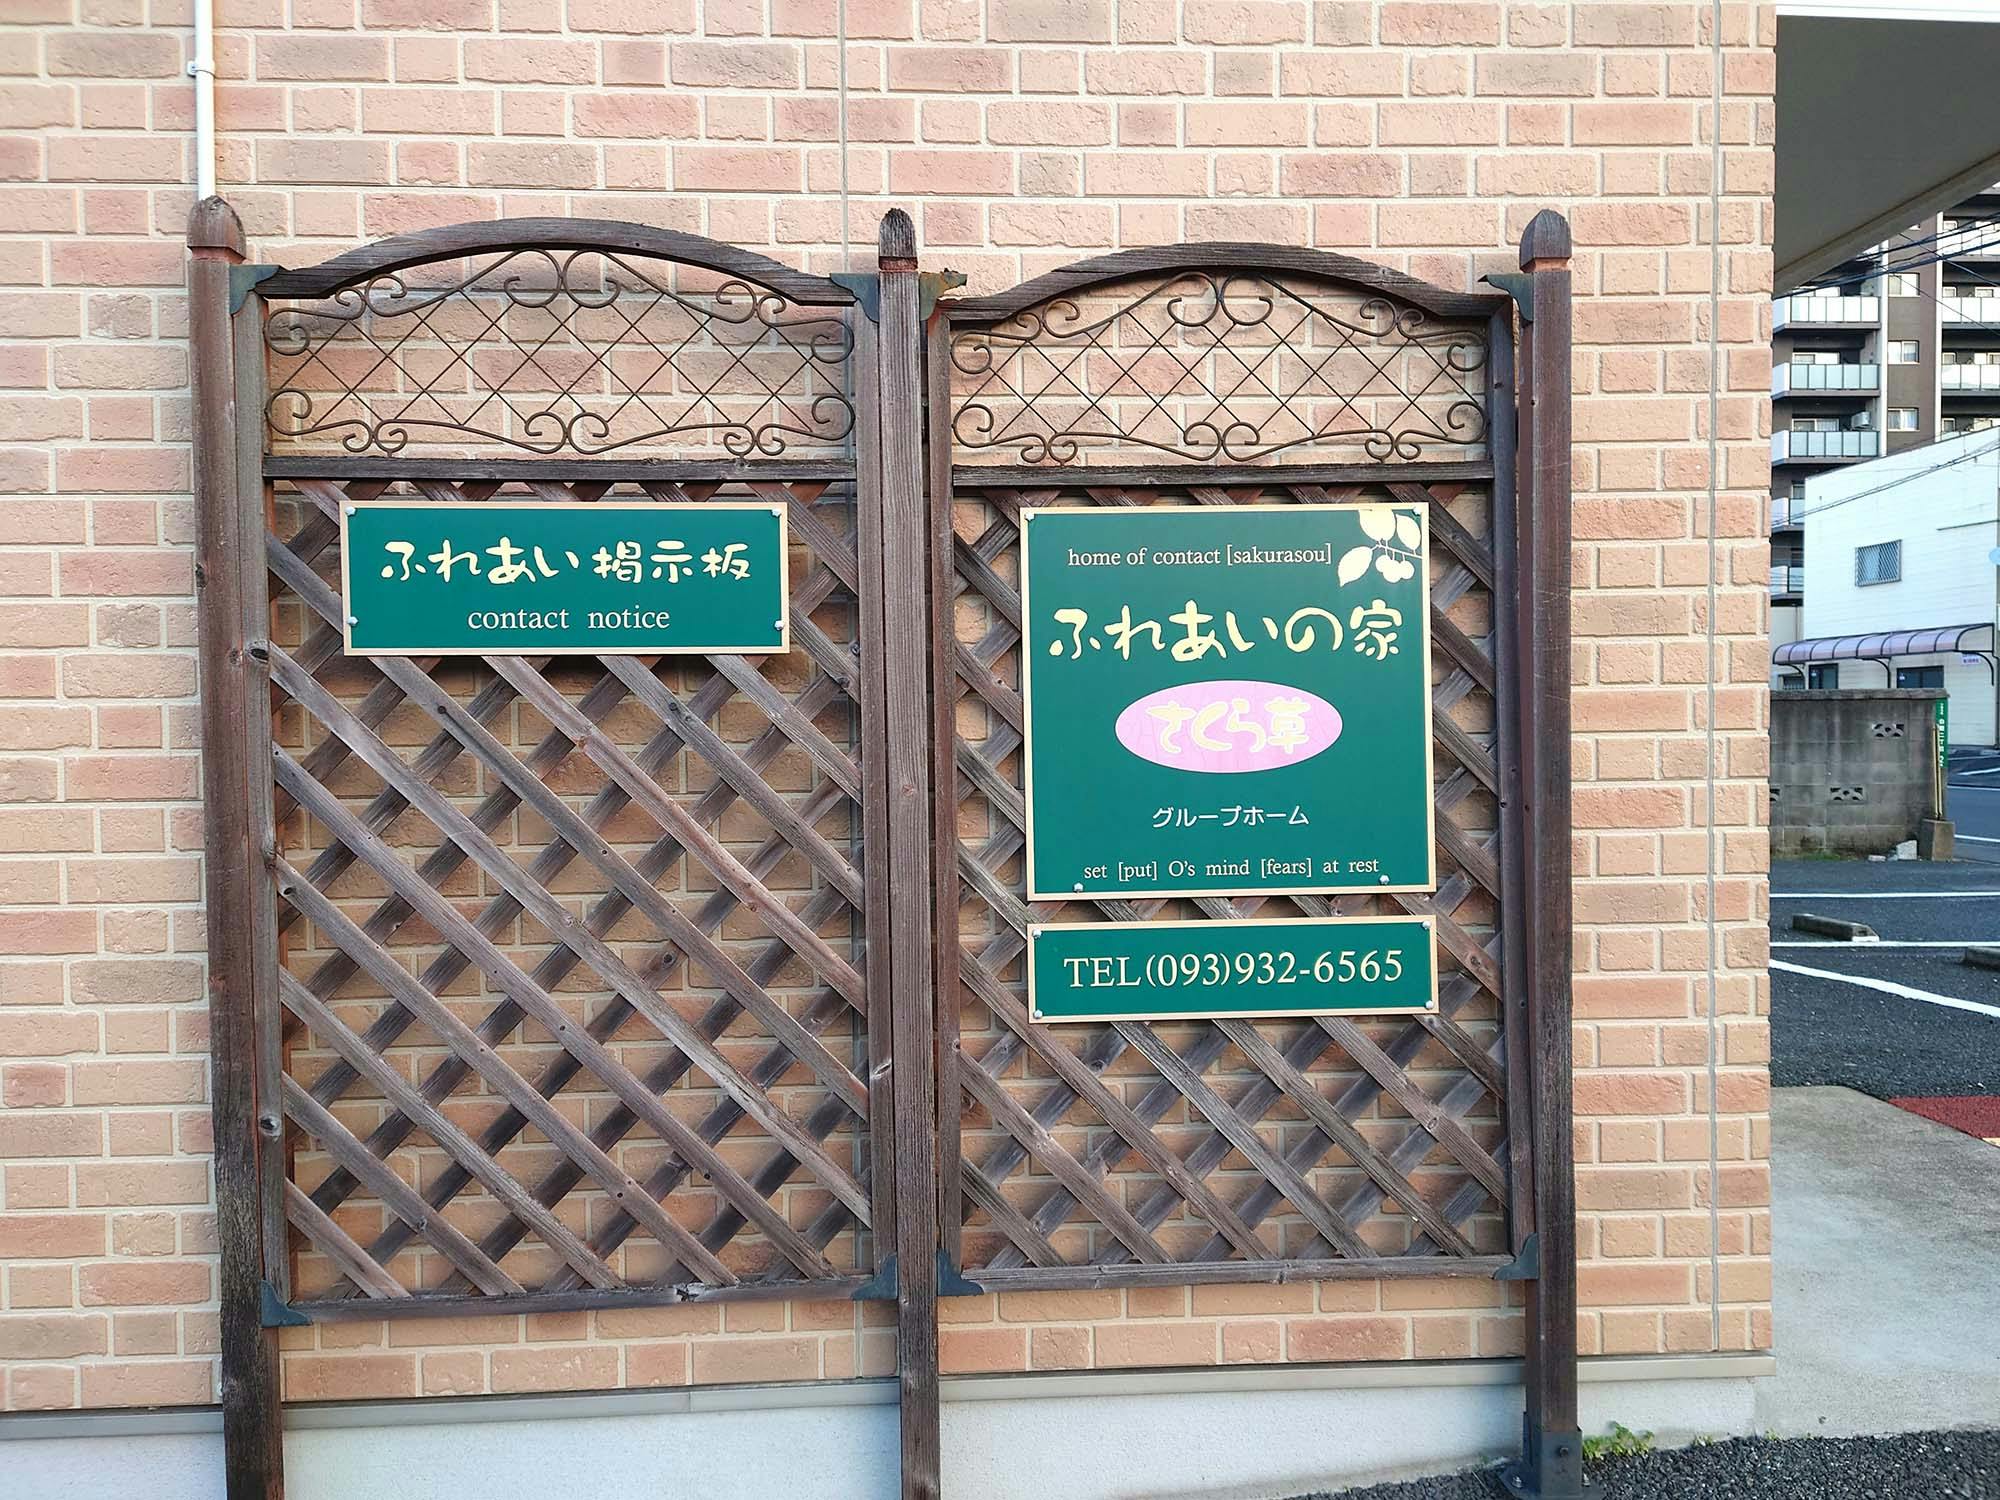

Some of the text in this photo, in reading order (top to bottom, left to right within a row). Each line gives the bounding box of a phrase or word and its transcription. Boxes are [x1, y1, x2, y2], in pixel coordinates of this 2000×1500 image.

[381, 536, 751, 584] ふれあい掲示板
[1068, 543, 1332, 566] home of contact [sakurasou]
[468, 605, 669, 629] contact notice
[1049, 599, 1403, 662] ふれあいの家
[1146, 698, 1311, 754] さくら草
[1152, 805, 1309, 828] グループホーム
[1084, 864, 1107, 879] set
[1118, 861, 1157, 882] [put]
[1206, 859, 1250, 876] mind
[1261, 857, 1312, 879] [fears]
[1323, 860, 1339, 874] at
[1349, 858, 1379, 874] rest
